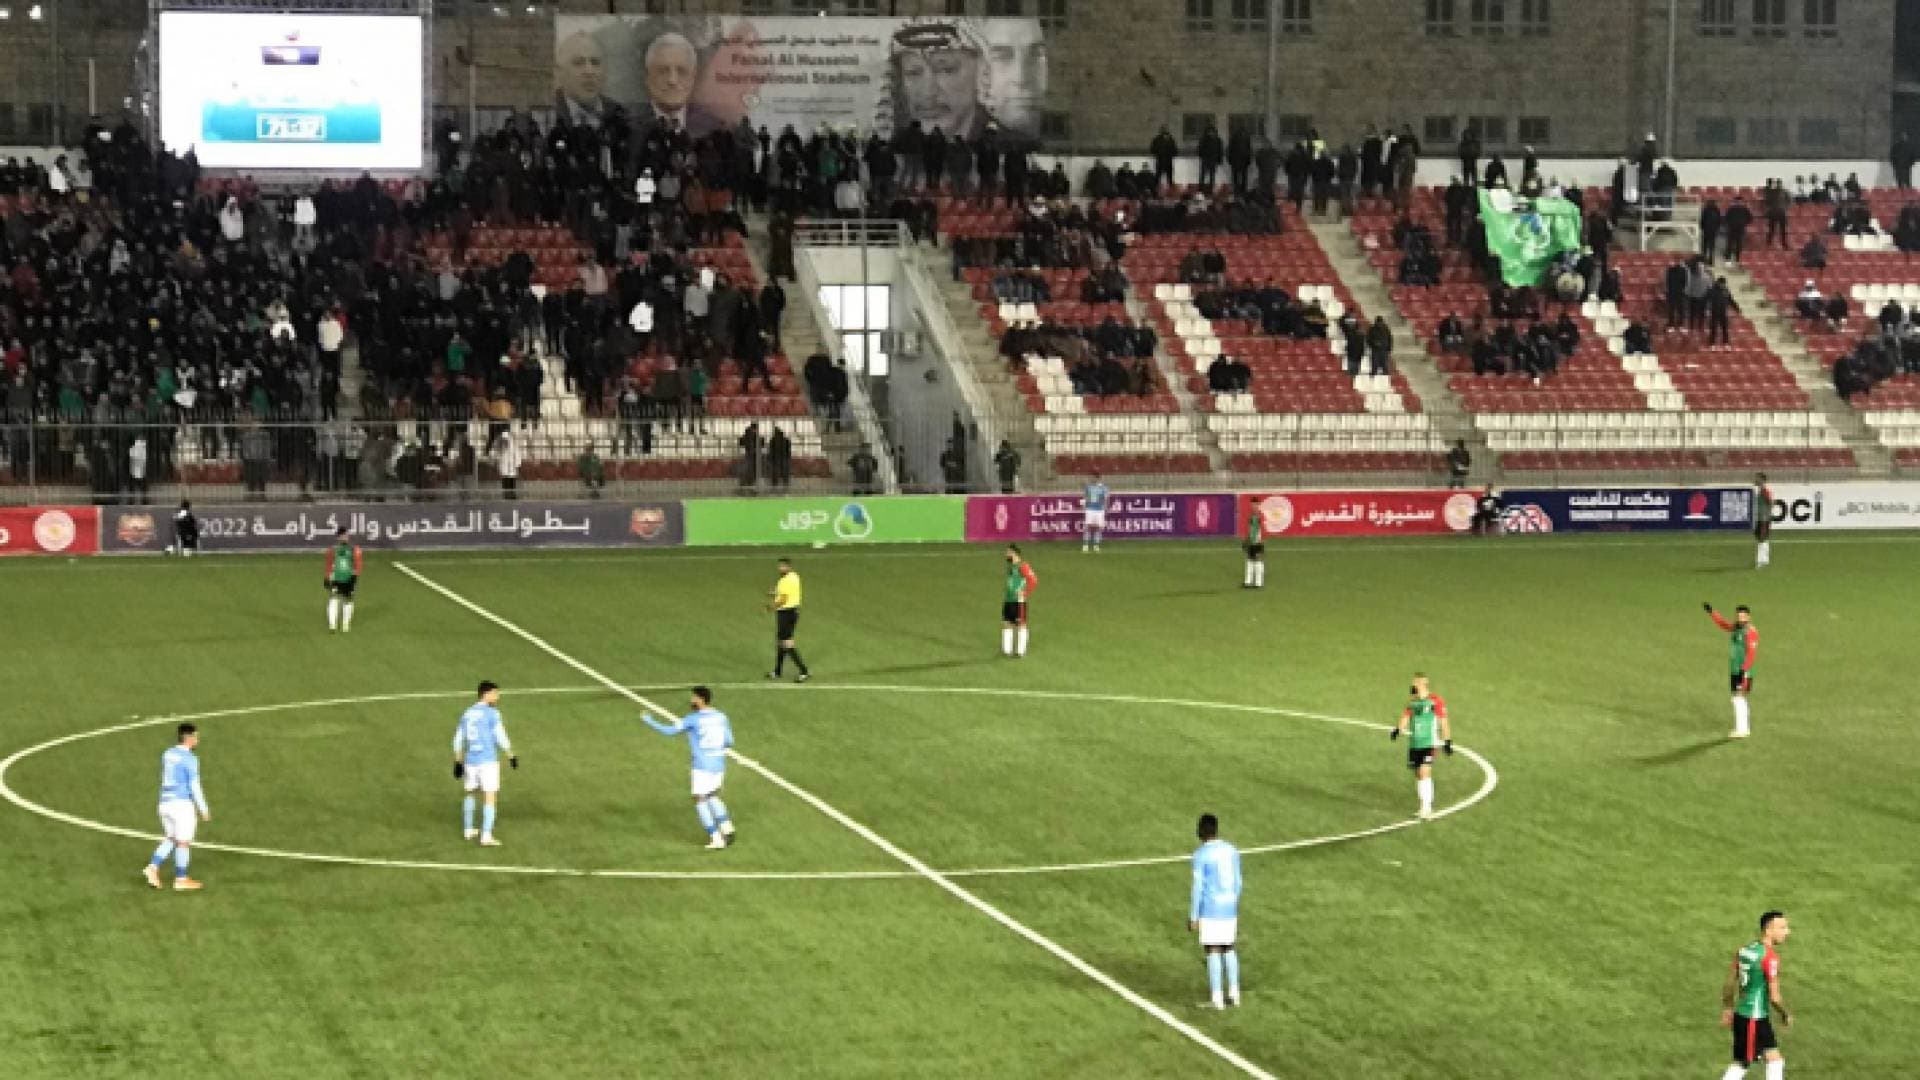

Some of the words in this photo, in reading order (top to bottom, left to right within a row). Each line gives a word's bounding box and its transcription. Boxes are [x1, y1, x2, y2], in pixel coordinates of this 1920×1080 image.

[731, 53, 773, 66] Faisal
[780, 53, 795, 66] Al
[715, 72, 808, 84] International
[812, 72, 870, 84] Stadium
[488, 510, 589, 538] بطولة
[1301, 503, 1364, 527] القدس
[199, 518, 247, 537] 2022
[386, 510, 482, 540] القدس
[1031, 520, 1071, 533] BANK
[1101, 518, 1173, 532] ALESTINE
